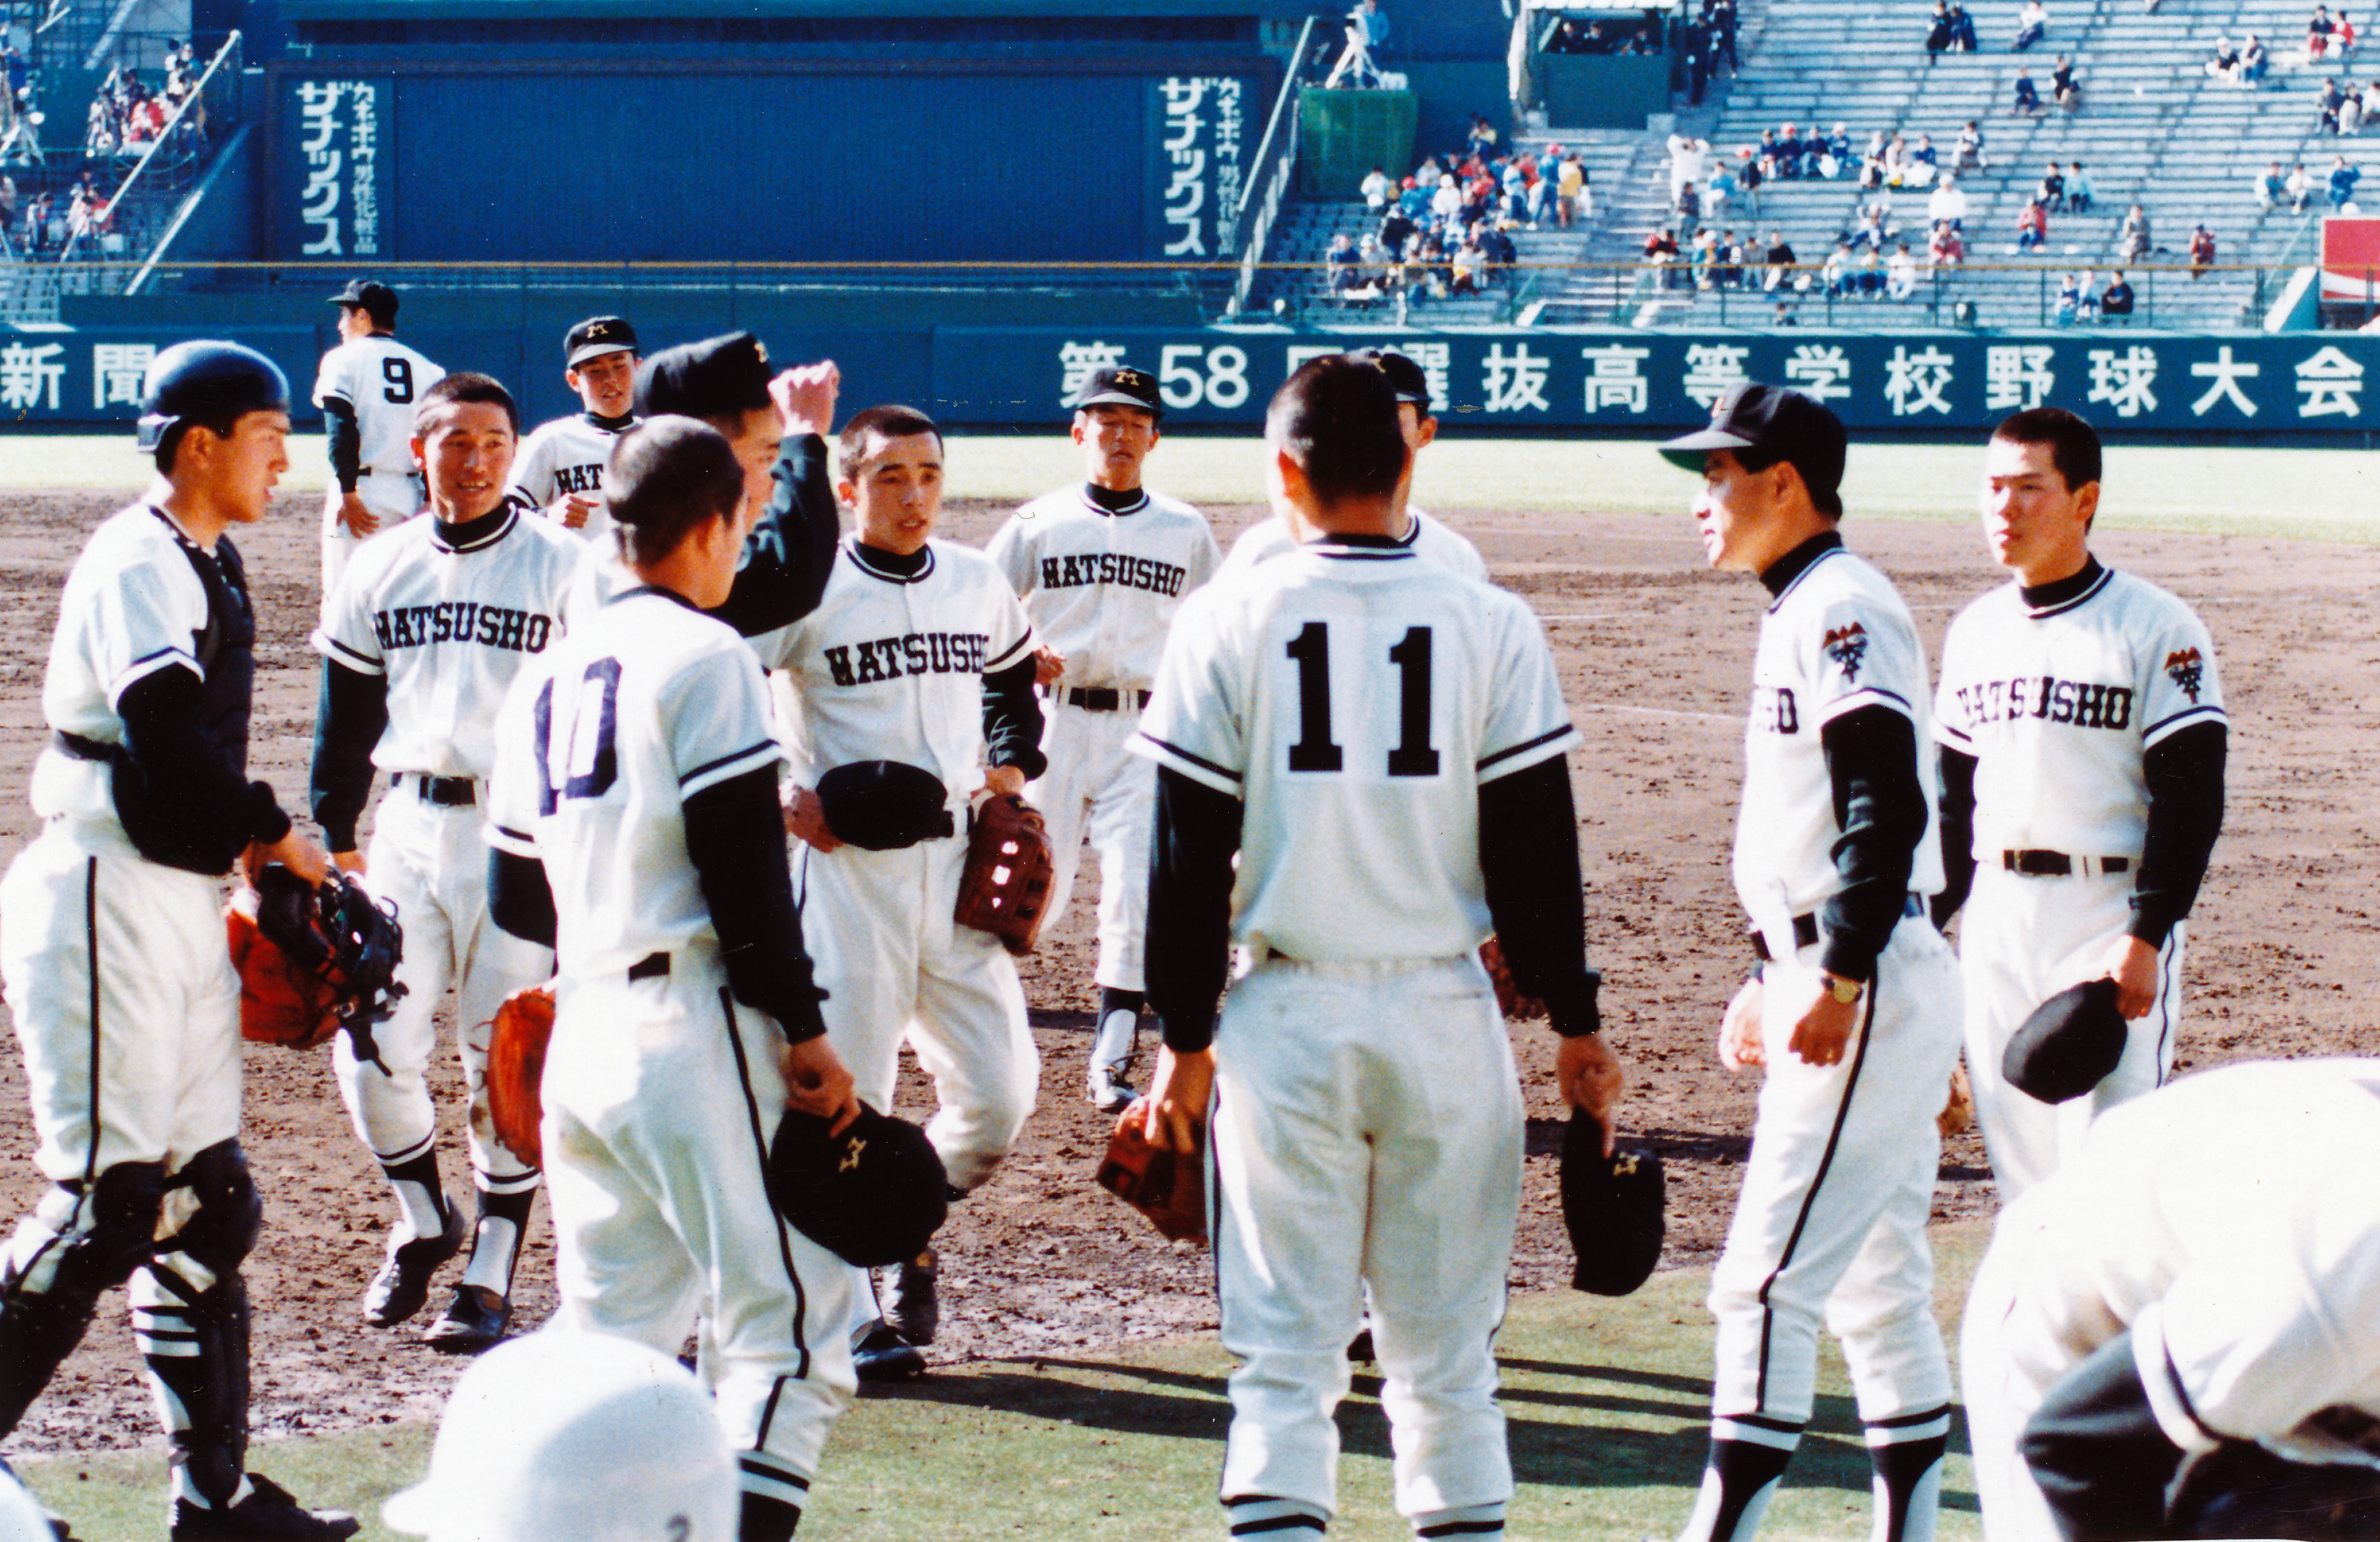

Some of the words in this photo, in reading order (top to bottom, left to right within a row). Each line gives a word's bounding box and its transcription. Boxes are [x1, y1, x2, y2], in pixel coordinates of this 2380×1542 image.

[295, 81, 353, 256] ザナックス
[1158, 76, 1219, 256] ザナックス
[0, 341, 156, 409] 新聞
[383, 357, 414, 404] 9
[1115, 371, 1140, 386] M
[554, 463, 604, 494] MAT
[1042, 553, 1186, 598] MATSUSHO
[373, 602, 552, 655] MATSUSHO
[824, 633, 990, 687] MATSUSH
[1286, 622, 1440, 776] 11
